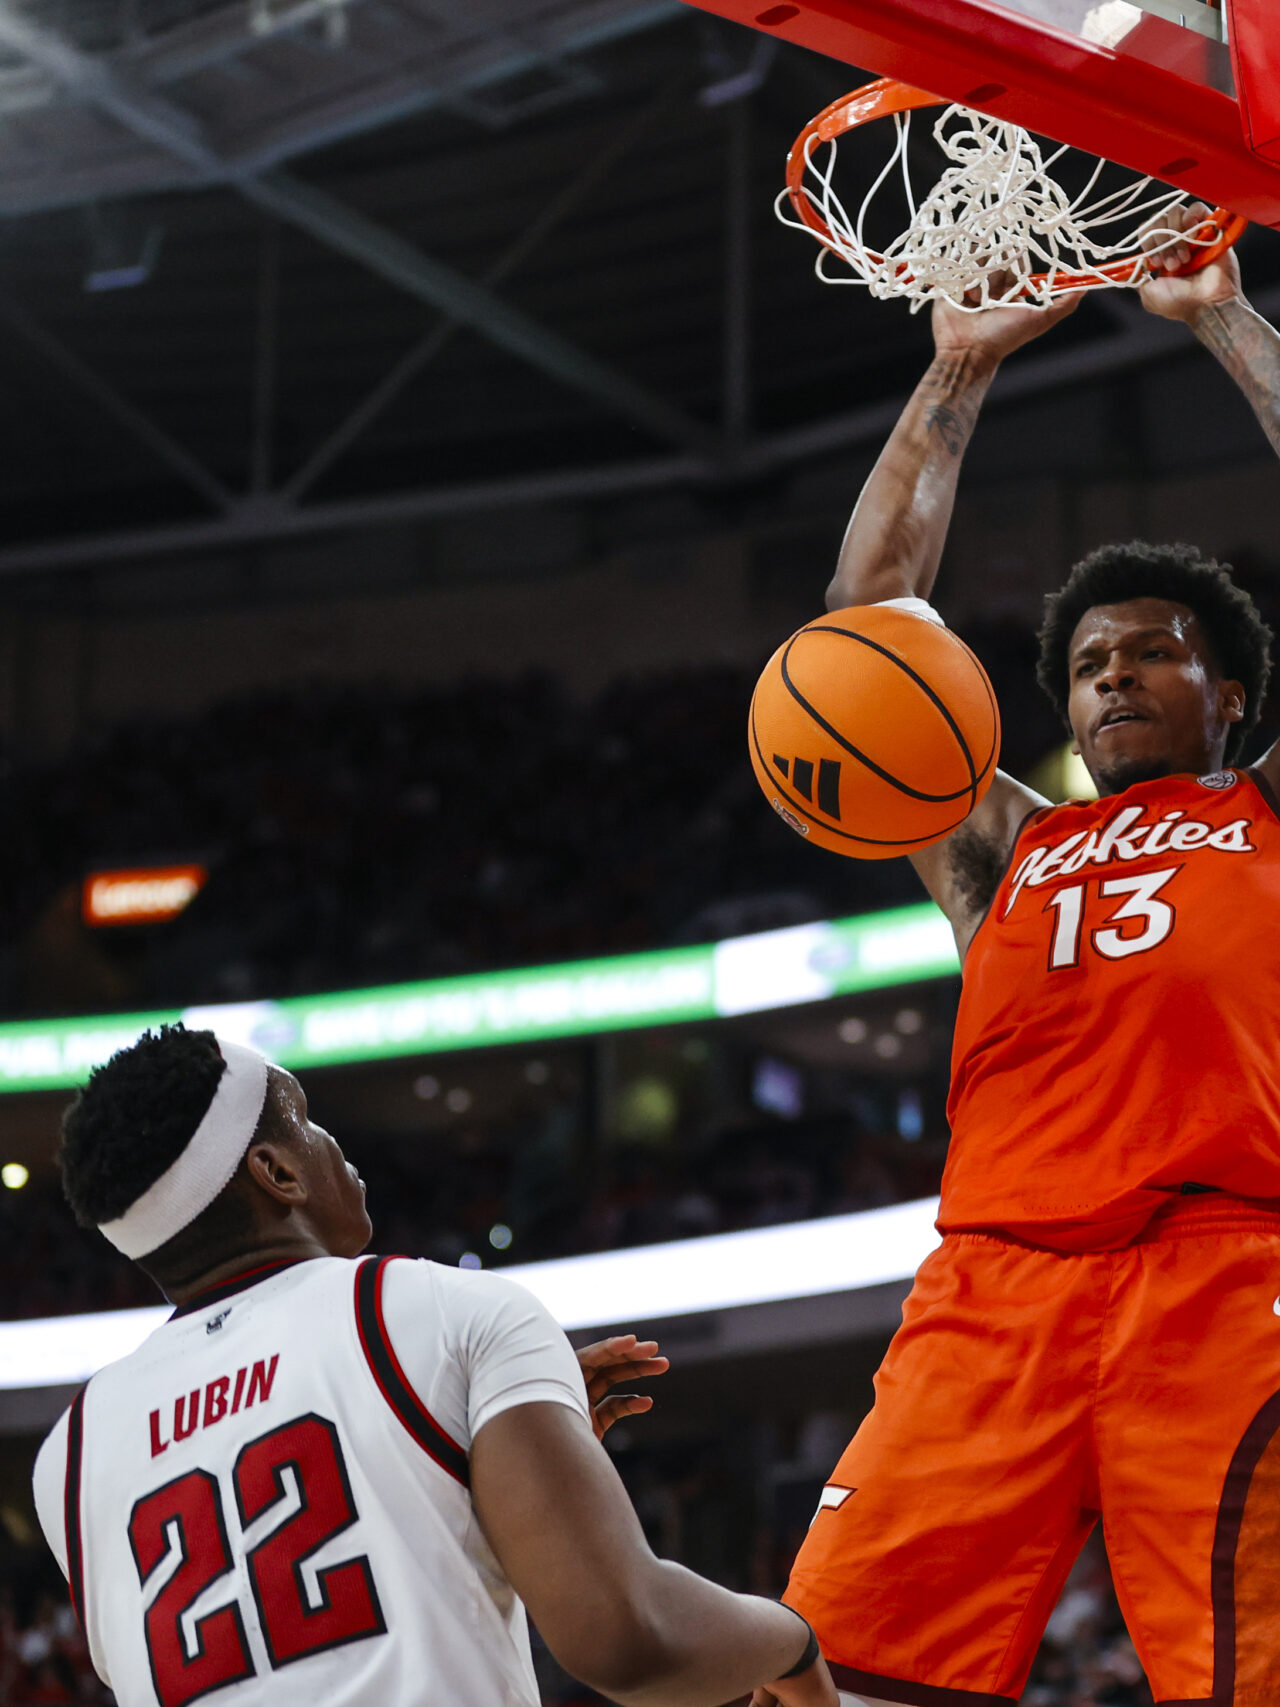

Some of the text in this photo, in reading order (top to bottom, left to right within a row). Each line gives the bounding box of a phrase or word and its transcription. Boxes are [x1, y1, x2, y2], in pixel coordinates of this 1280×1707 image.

[1042, 863, 1186, 972] 13
[149, 1353, 280, 1458] LUBIN
[127, 1412, 388, 1707] 22
